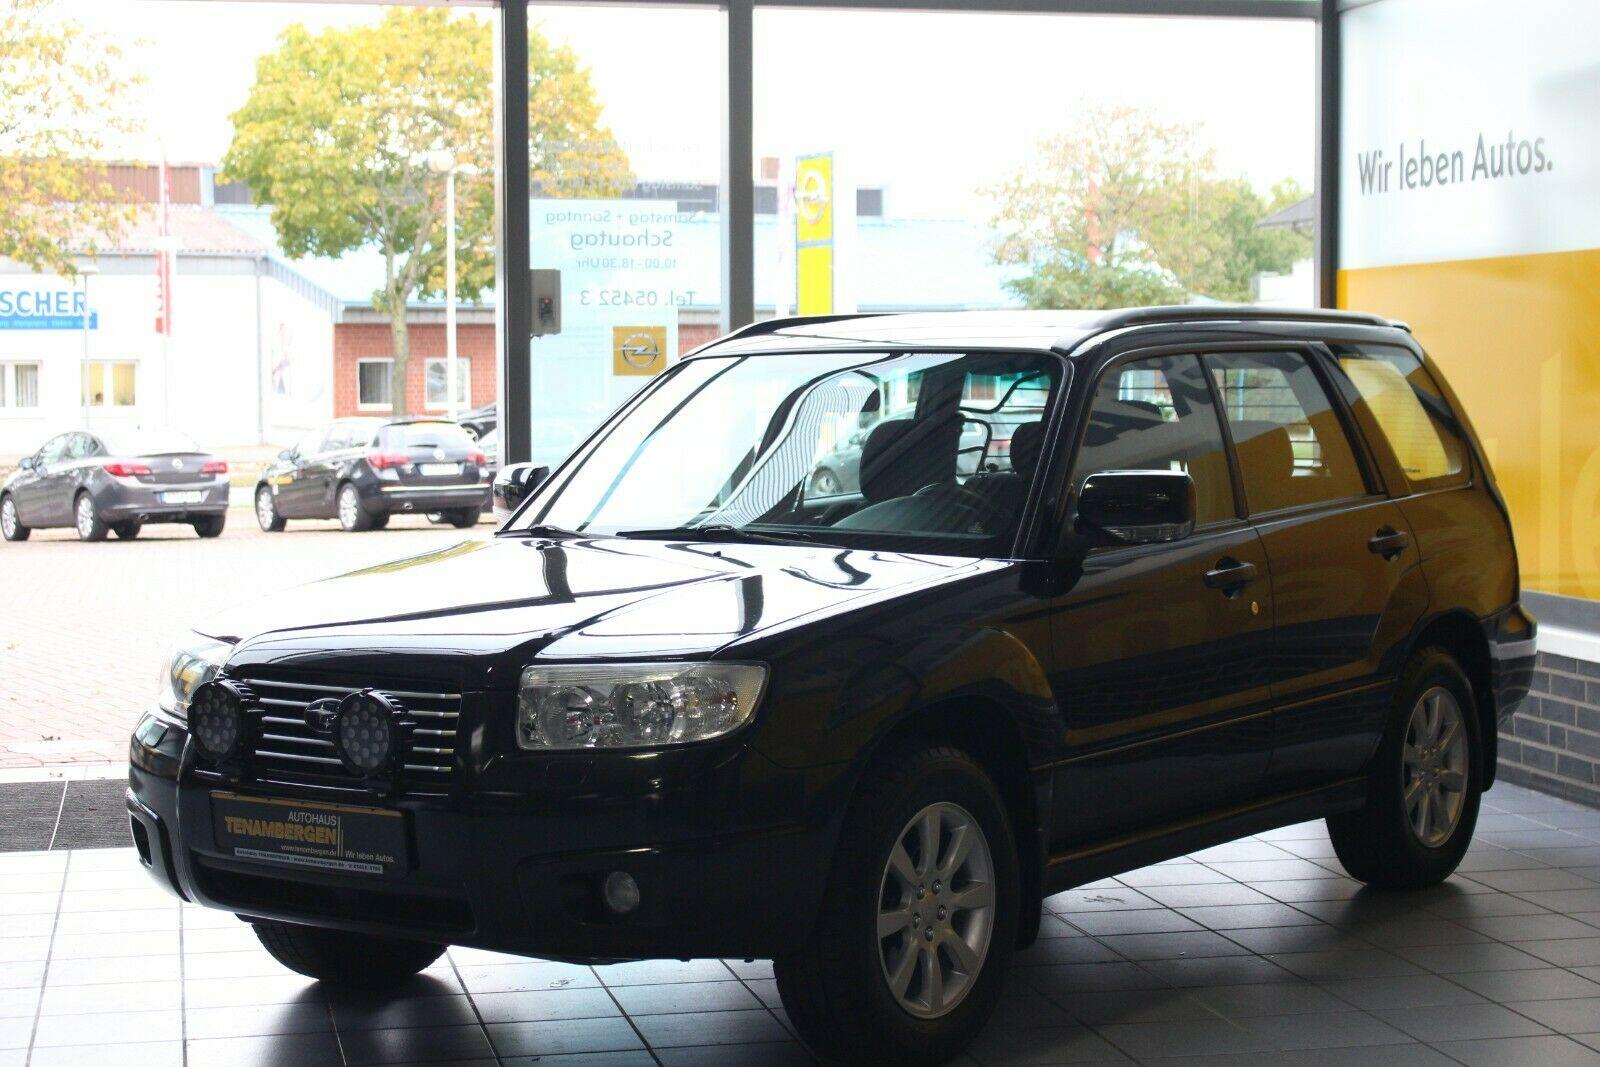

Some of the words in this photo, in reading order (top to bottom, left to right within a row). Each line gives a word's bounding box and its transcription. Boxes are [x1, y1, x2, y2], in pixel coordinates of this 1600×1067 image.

[1357, 149, 1393, 196] Wir
[1399, 138, 1465, 192] leben
[1471, 128, 1554, 182] Autos.
[0, 291, 87, 313] SCHER
[287, 810, 337, 826] AUTOHAUS
[224, 816, 337, 845] TENAMBERGEN
[344, 850, 356, 859] Wir
[356, 851, 374, 862] leben
